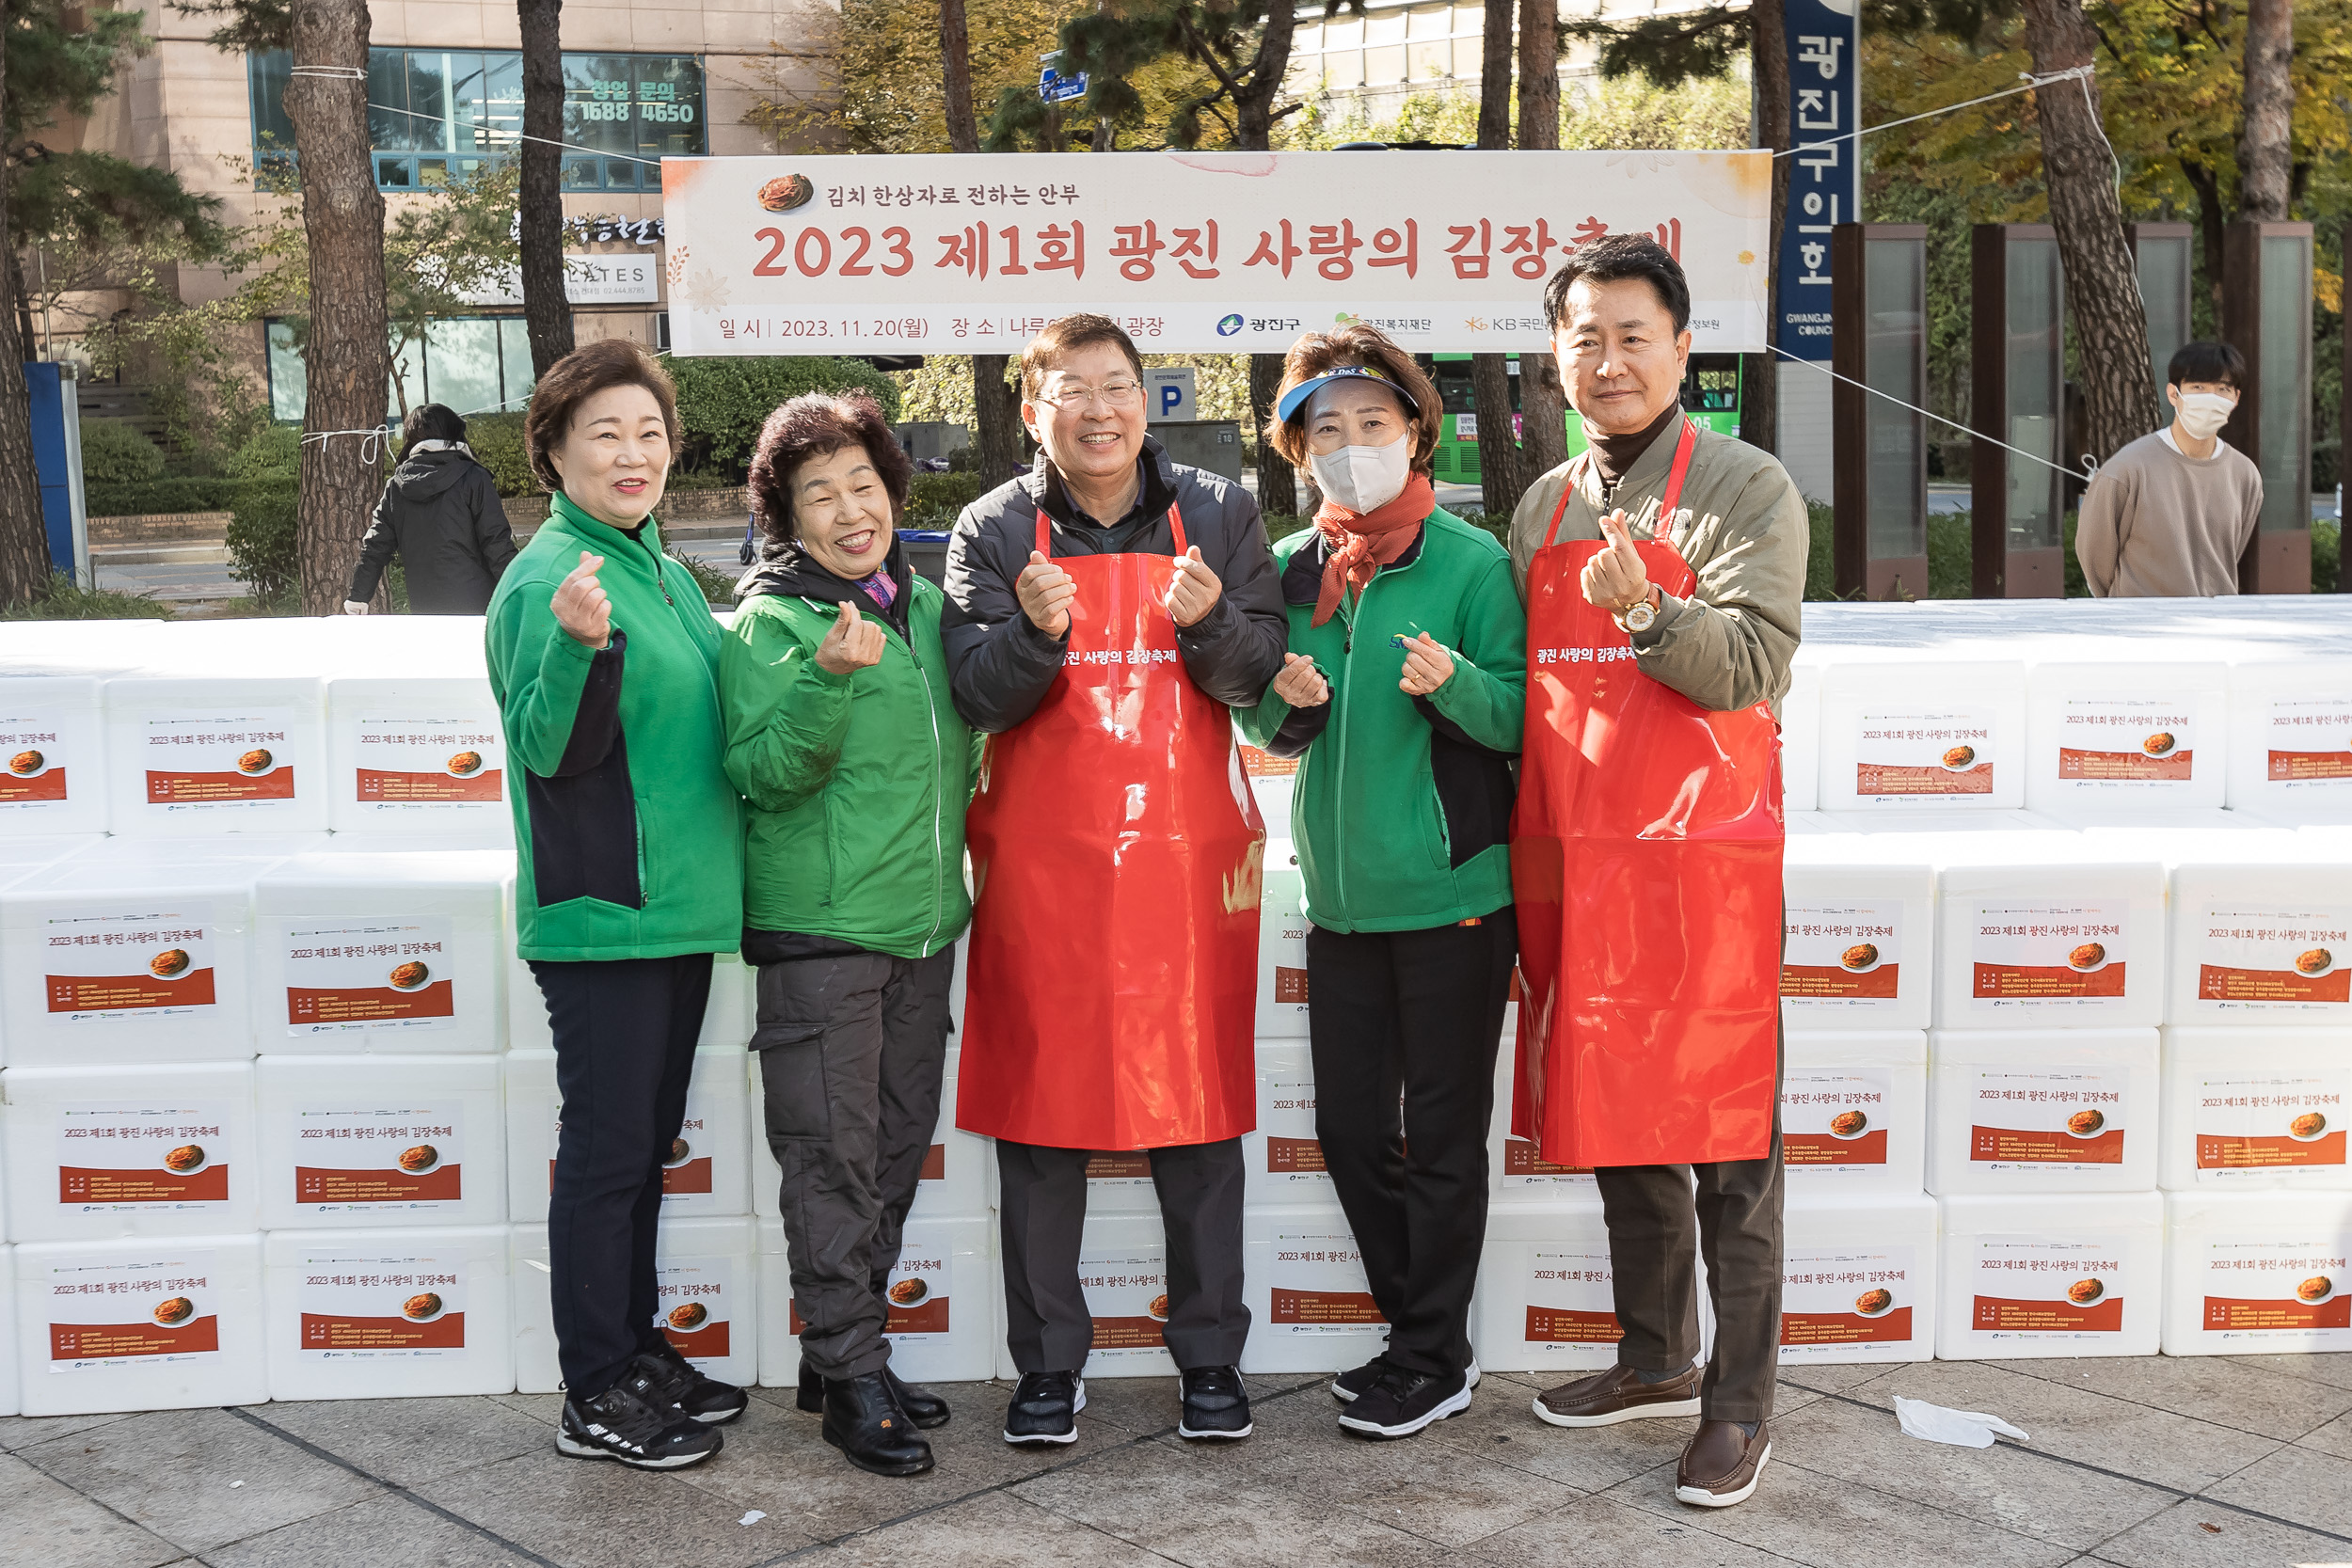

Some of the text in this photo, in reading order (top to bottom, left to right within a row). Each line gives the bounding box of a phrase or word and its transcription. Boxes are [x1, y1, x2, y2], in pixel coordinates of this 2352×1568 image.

[593, 80, 675, 103] 창업 문의
[580, 102, 694, 123] 1688 4650
[827, 183, 1081, 208] 김치 한상자로 전하는 안부
[753, 226, 914, 278] 2023
[934, 219, 1085, 282] 제1회
[1108, 218, 1221, 282] 광진
[1242, 217, 1418, 280] 사랑의
[1126, 317, 1165, 337] 광장
[1249, 318, 1301, 331] 광진구
[1161, 386, 1183, 417] P
[1084, 650, 1122, 665] 사랑의
[1125, 648, 1177, 665] 김장축제
[1537, 648, 1557, 664] 광진
[1559, 647, 1594, 663] 사랑의
[2066, 715, 2188, 726] 2023 제1회 광진 사랑의 김장축제
[148, 731, 285, 745] 2023 제1회 광진 사랑의 김장축제
[360, 734, 495, 746] 2023 제1회 광진 사랑의 김장축제
[1863, 729, 1988, 740] 2023 제1회 광진 사랑의 김장축제
[48, 928, 203, 946] 2023 제1회 광진 사랑의 김장축제
[1282, 929, 1304, 940] 2023
[1786, 925, 1893, 937] 1회 광진 사랑의 김장축제
[1979, 924, 2120, 937] 2023 제1회 광진 사랑의 김장축제
[2208, 928, 2347, 942] 2023 제1회 광진 사랑의 김장축제
[290, 941, 442, 959] 2023 제1회 광진 사랑의 김장축제
[1790, 1092, 1882, 1104] 광진 사랑의 김장축제
[1979, 1089, 2119, 1103] 2023 제1회 광진 사랑의 김장축제
[2201, 1093, 2340, 1108] 2023 제1회 광진 사랑의 김장축제
[1273, 1100, 1295, 1109] 2023
[64, 1125, 219, 1139] 2023 제1회 광진 사랑의 김장축제
[300, 1125, 453, 1140] 2023 제1회 광진 사랑의 김장축제
[1278, 1252, 1298, 1260] 2023
[1300, 1251, 1325, 1262] 제1회
[1327, 1251, 1347, 1262] 광진
[902, 1259, 942, 1272] 김장축제
[1980, 1259, 2119, 1273] 2023 제1회 광진 사랑의 김장축제
[2210, 1257, 2346, 1271] 2023 제1회 광진 사랑의 김장축제
[306, 1274, 457, 1287] 2023 제1회 광진 사랑의 김장축제
[1106, 1275, 1127, 1287] 광진
[1128, 1275, 1158, 1286] 사랑의
[1534, 1270, 1555, 1279] 2023
[1556, 1270, 1581, 1281] 제1회
[1583, 1271, 1603, 1282] 광진
[1788, 1270, 1905, 1284] 제1회 광진 사랑의 김장축제
[53, 1276, 207, 1295] 2023 제1회 광진 사랑의 김장축제
[658, 1283, 721, 1296] 랑의 김장축제
